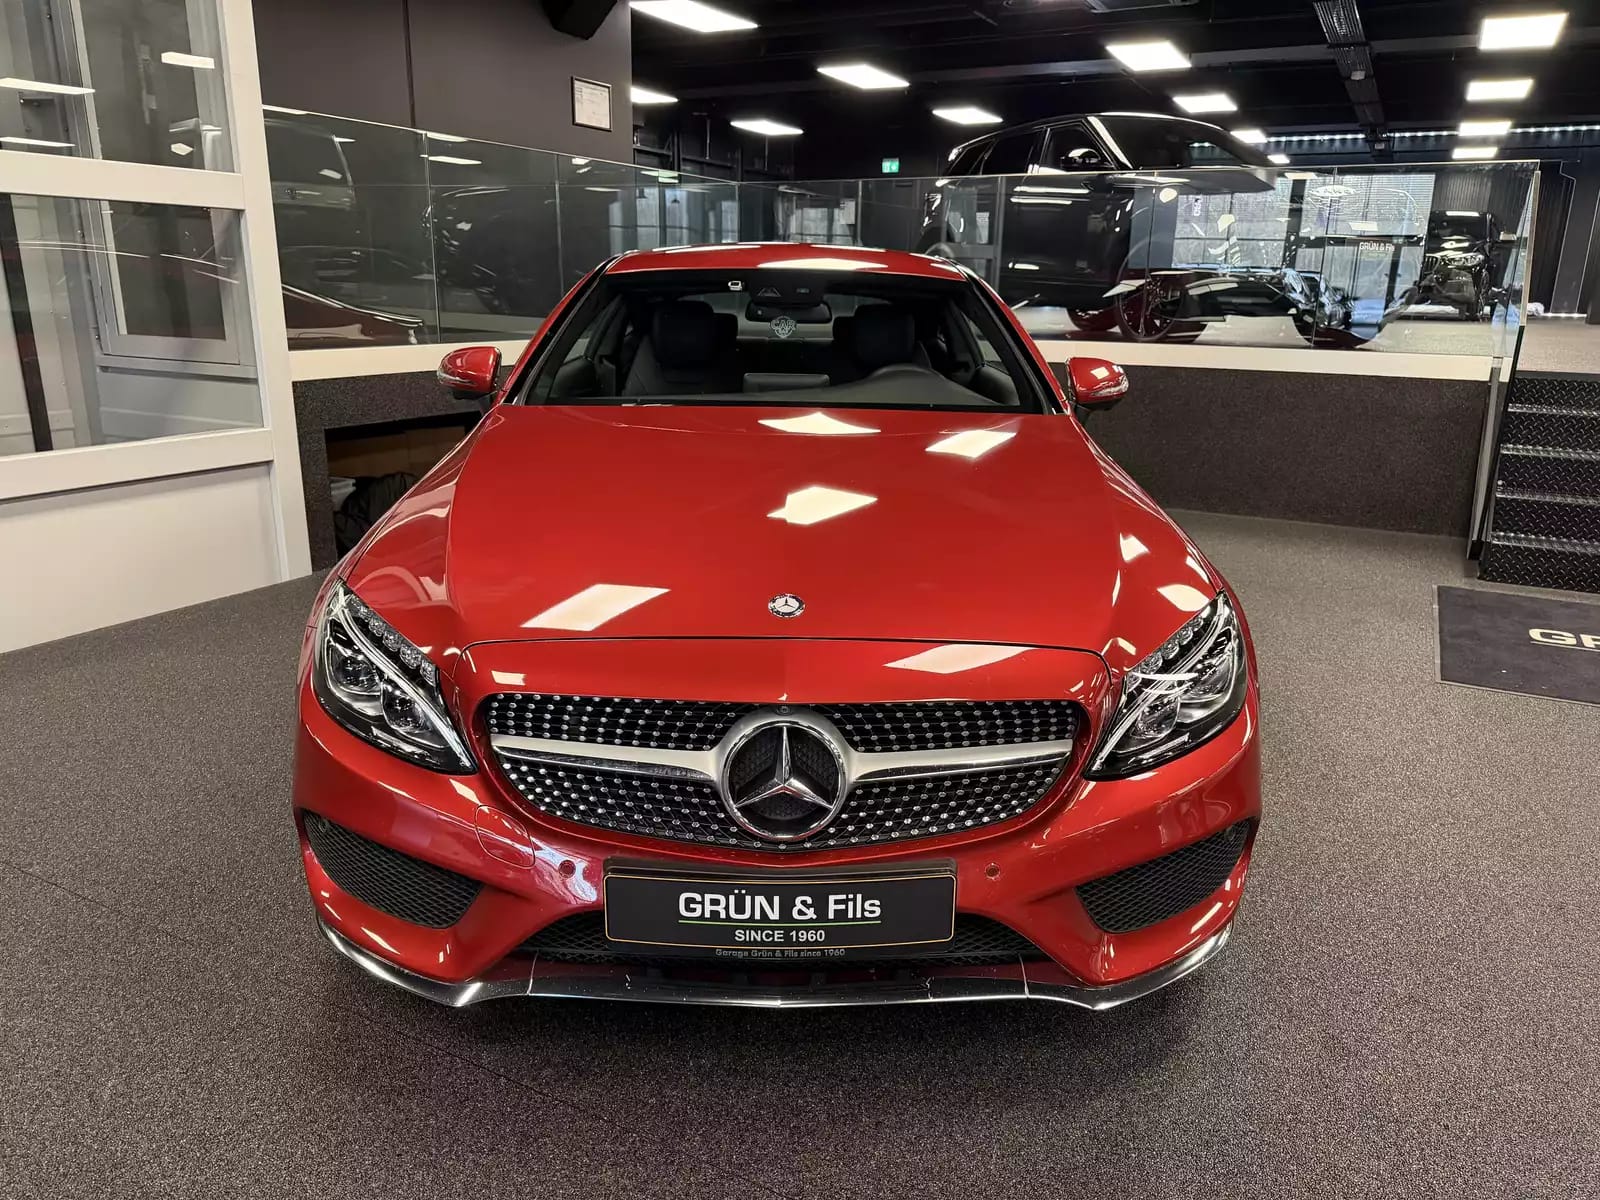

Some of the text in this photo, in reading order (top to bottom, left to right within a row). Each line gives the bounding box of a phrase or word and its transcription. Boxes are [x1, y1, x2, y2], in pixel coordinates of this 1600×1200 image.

[678, 889, 882, 920] GRÜN & Fils
[734, 929, 826, 942] SINCE 1960
[715, 948, 749, 959] Garage
[751, 949, 773, 958] Grün
[775, 950, 783, 958] &
[784, 949, 798, 958] Fils
[824, 948, 846, 957] 1960
